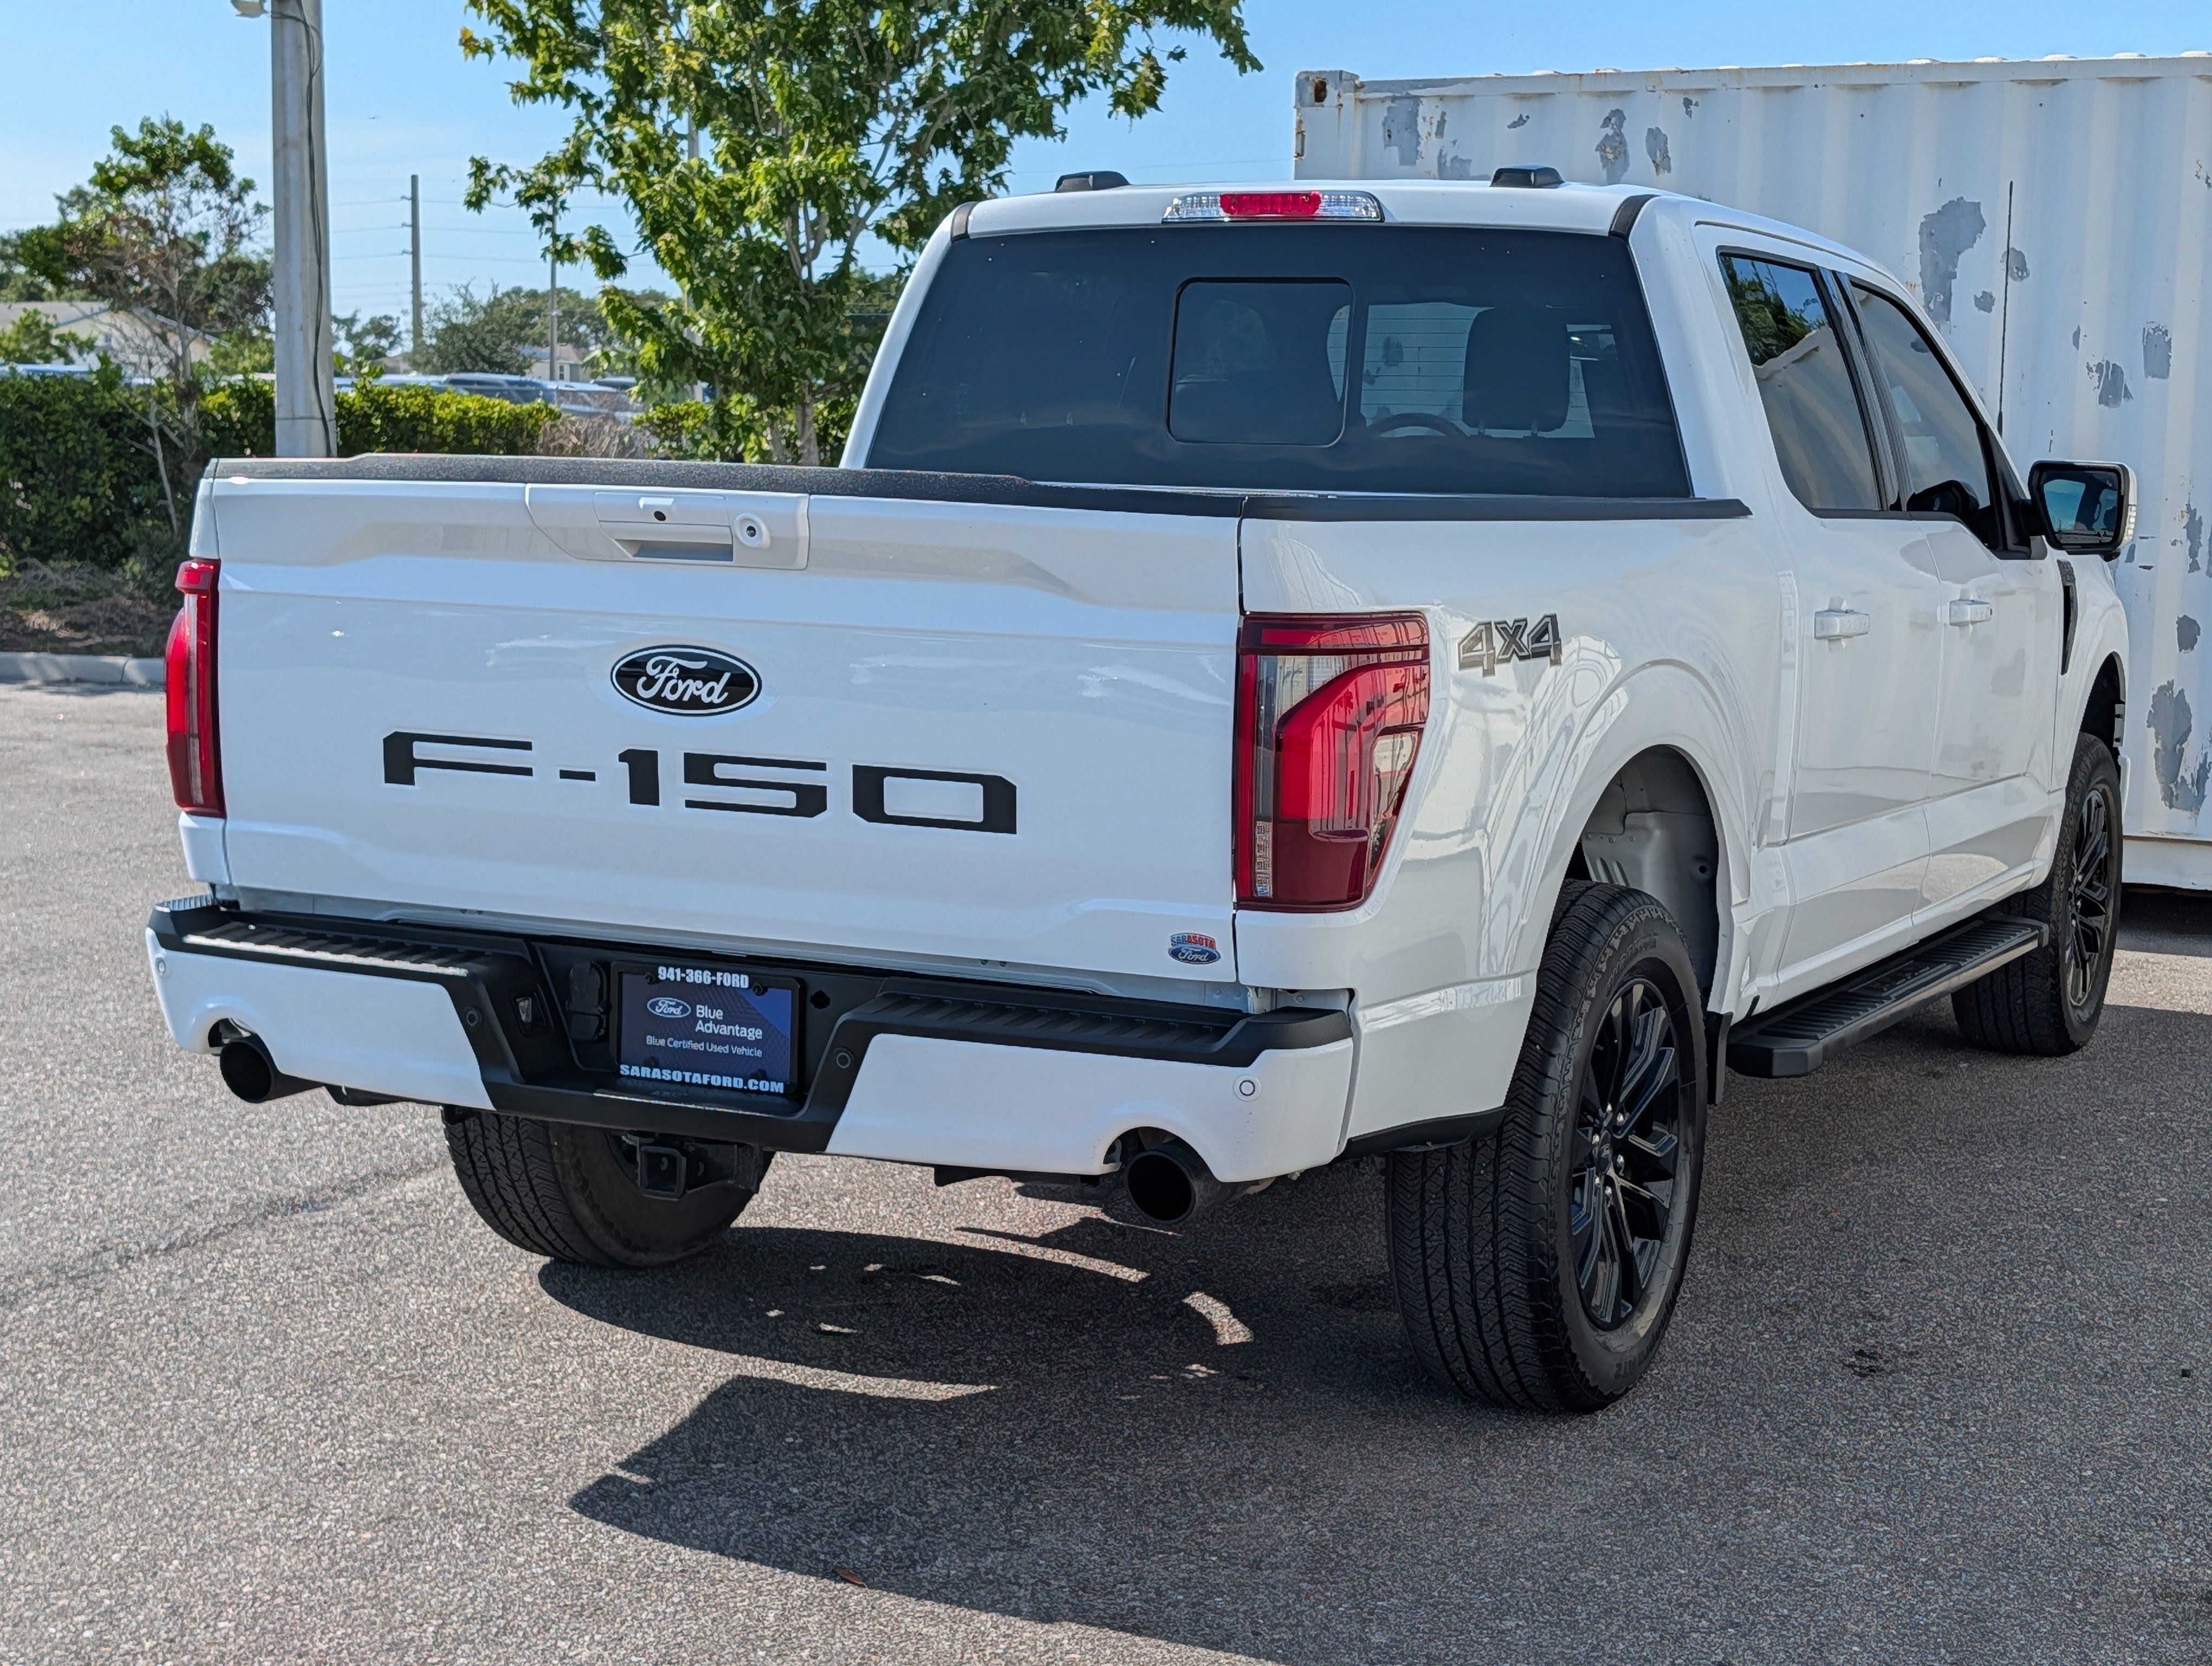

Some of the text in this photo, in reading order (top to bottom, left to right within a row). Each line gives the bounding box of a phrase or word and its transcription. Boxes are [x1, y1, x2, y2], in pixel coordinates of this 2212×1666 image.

[635, 654, 732, 706] Ford
[382, 730, 1018, 835] F-150
[1178, 947, 1210, 962] Ford
[657, 965, 750, 989] 941-366-FORD
[654, 999, 683, 1015] Ford
[696, 1004, 724, 1020] Blue
[695, 1019, 763, 1041] Advantage
[646, 1035, 763, 1058] Blue Certified Used Vehicle
[620, 1063, 785, 1093] SARASOTAFORD.COM
